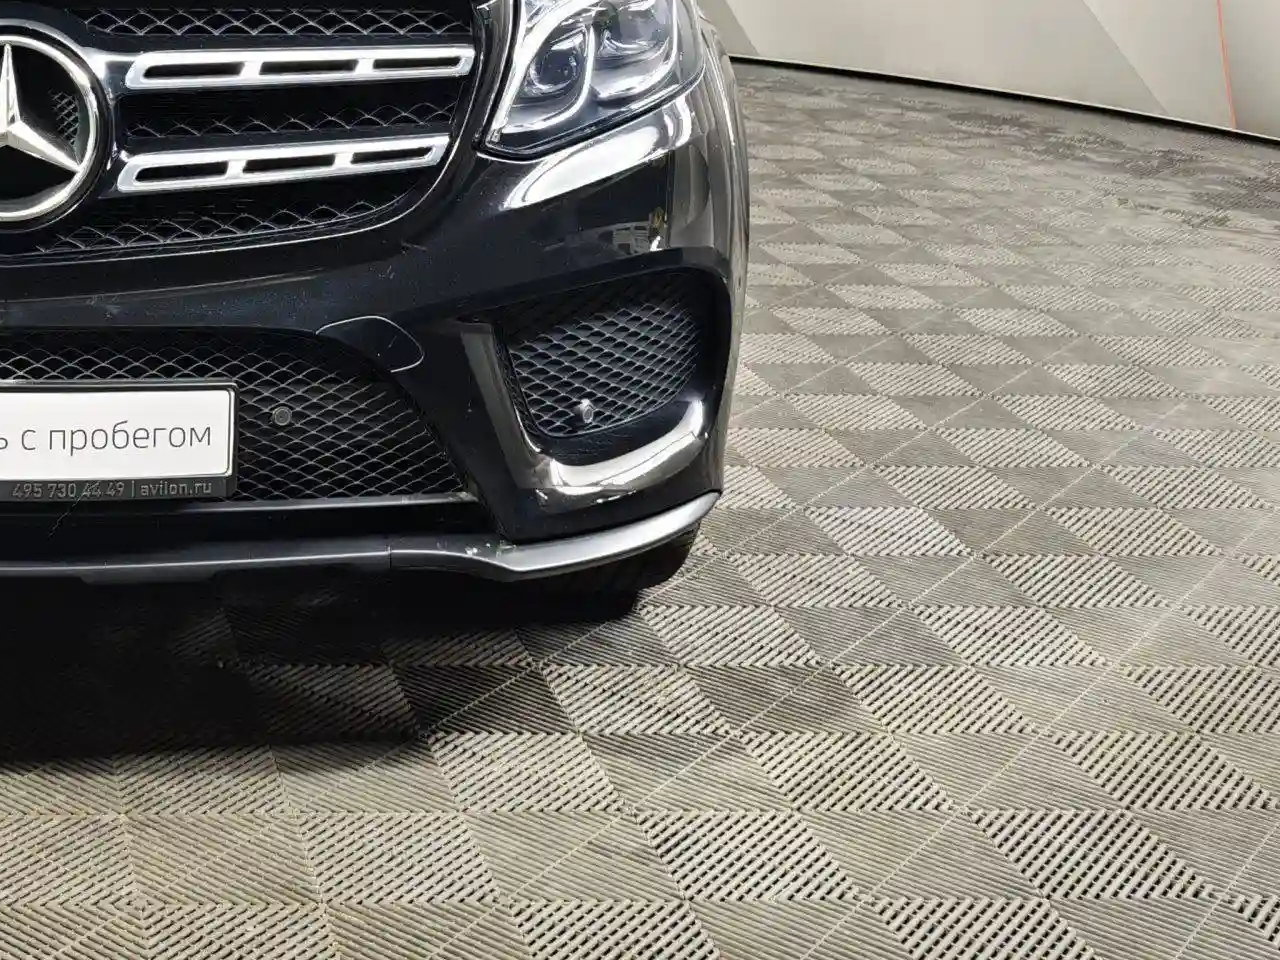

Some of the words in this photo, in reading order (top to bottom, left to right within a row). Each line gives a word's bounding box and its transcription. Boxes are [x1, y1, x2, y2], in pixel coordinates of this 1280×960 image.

[21, 429, 36, 451] с
[49, 420, 211, 456] пробегом
[12, 483, 42, 498] 495
[47, 483, 77, 498] 730
[106, 481, 125, 497] 49
[140, 480, 213, 496] avilon.ru
